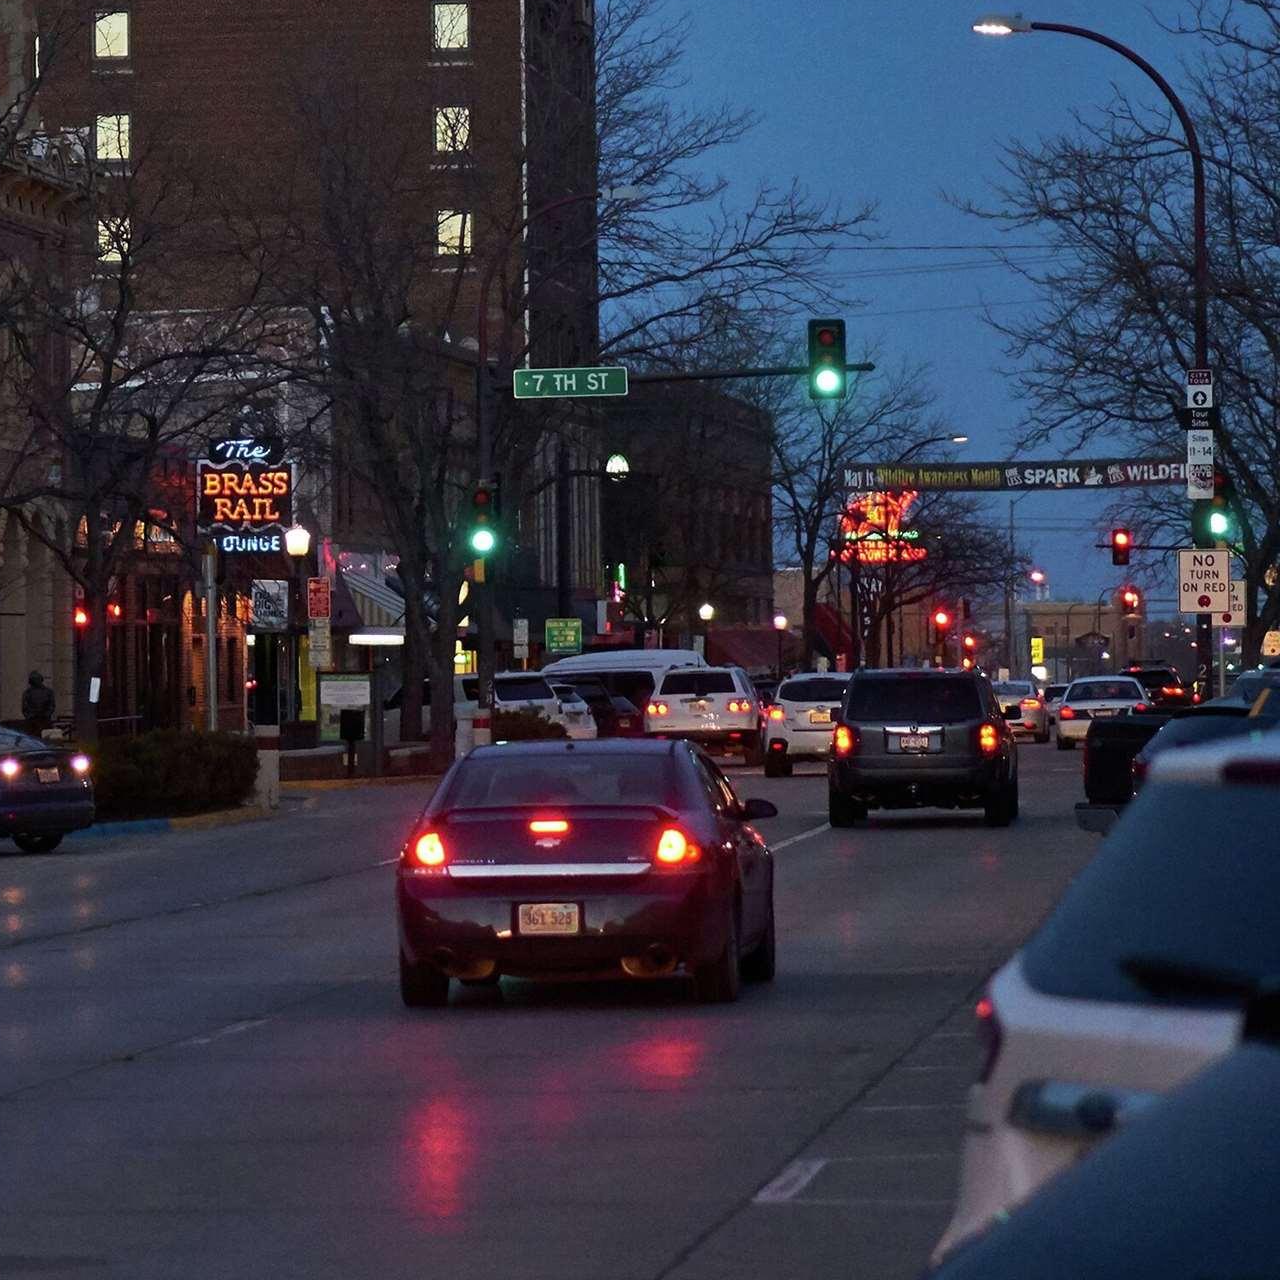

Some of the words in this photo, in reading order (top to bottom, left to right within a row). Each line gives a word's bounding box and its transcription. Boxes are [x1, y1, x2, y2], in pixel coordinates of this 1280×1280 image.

[532, 375, 544, 392] 7
[553, 374, 576, 391] TH
[587, 373, 609, 390] ST
[215, 439, 271, 458] The
[844, 469, 862, 488] May
[877, 468, 915, 486] Wildfire
[919, 469, 968, 483] Awareness
[971, 468, 1001, 483] Month
[1024, 467, 1081, 484] SPARK
[1127, 463, 1189, 481] WILDFI
[203, 472, 288, 495] BRASS
[214, 497, 280, 521] RAIL
[1193, 555, 1215, 567] NO
[1190, 570, 1219, 579] TURN
[1183, 583, 1198, 592] ON
[1204, 583, 1226, 592] RED
